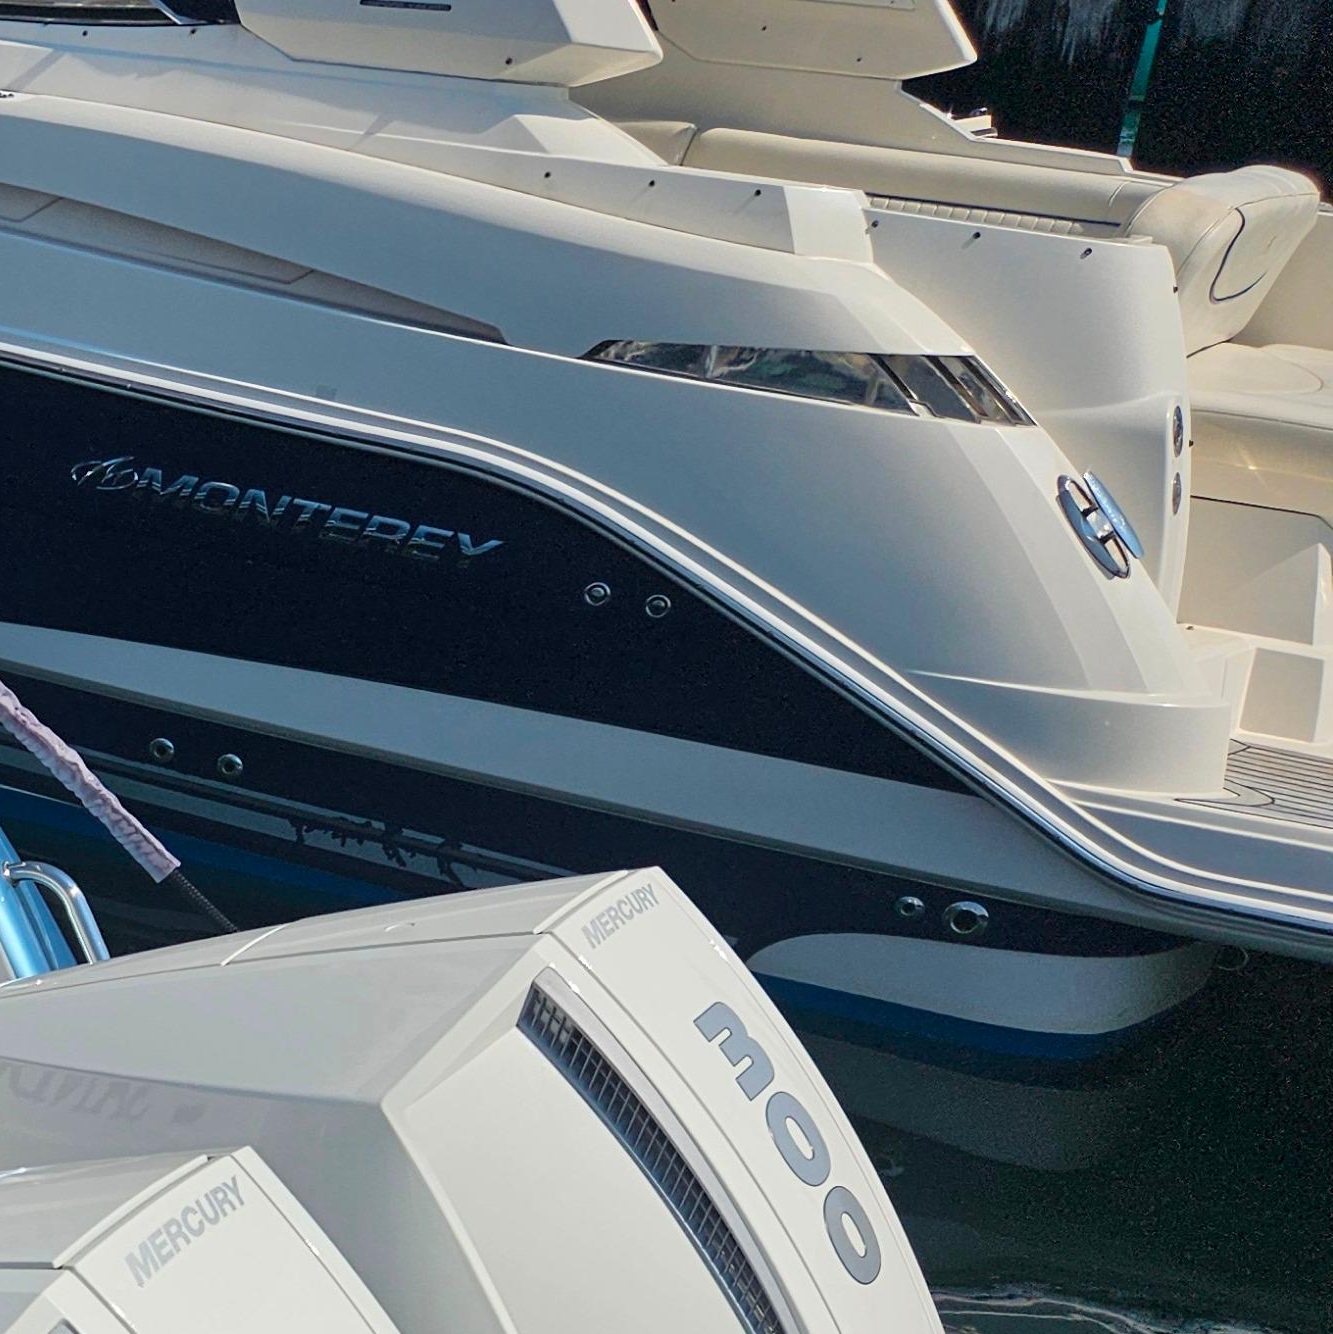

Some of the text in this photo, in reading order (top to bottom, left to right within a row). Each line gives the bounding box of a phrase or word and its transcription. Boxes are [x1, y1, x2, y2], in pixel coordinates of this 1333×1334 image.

[136, 467, 504, 562] MONTEREY
[581, 883, 659, 949] MERCURY
[693, 1001, 882, 1285] 300
[124, 1174, 245, 1288] MERCURY
